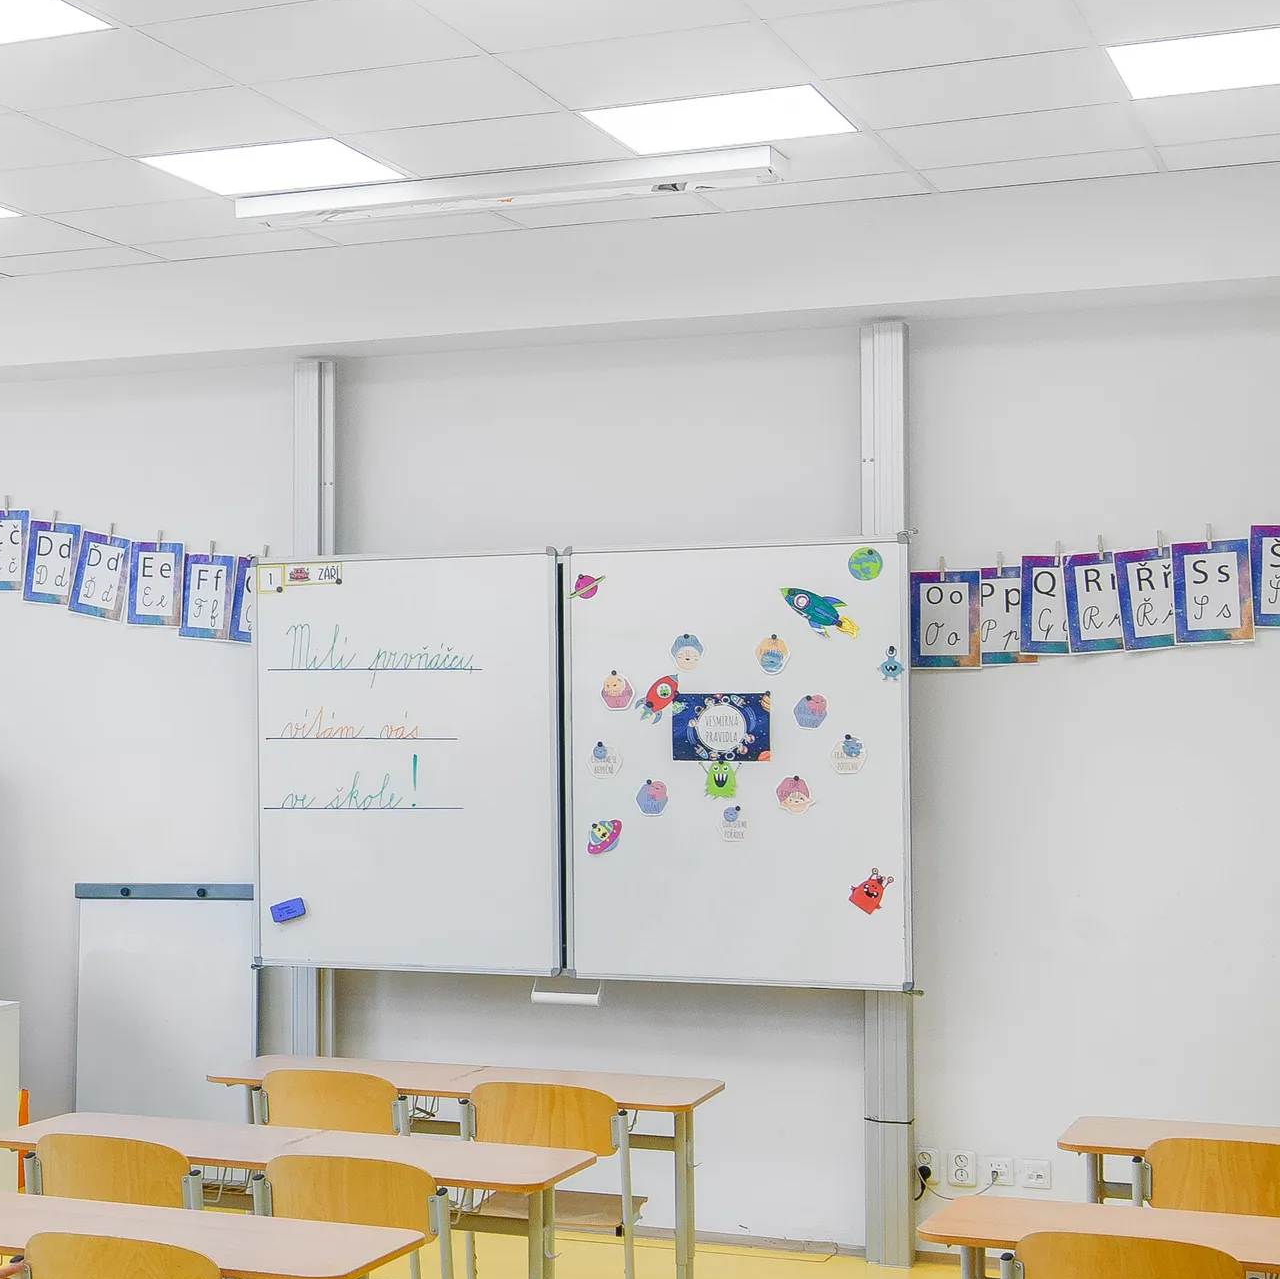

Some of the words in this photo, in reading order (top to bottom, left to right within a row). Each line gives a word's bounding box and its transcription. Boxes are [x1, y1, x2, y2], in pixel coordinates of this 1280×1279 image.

[318, 565, 340, 581] ZÁŘÍ
[286, 623, 356, 669] Milí
[281, 705, 364, 739] vítám
[380, 711, 419, 739] vás
[705, 731, 738, 743] PRAVIDLA
[281, 793, 316, 809] ve
